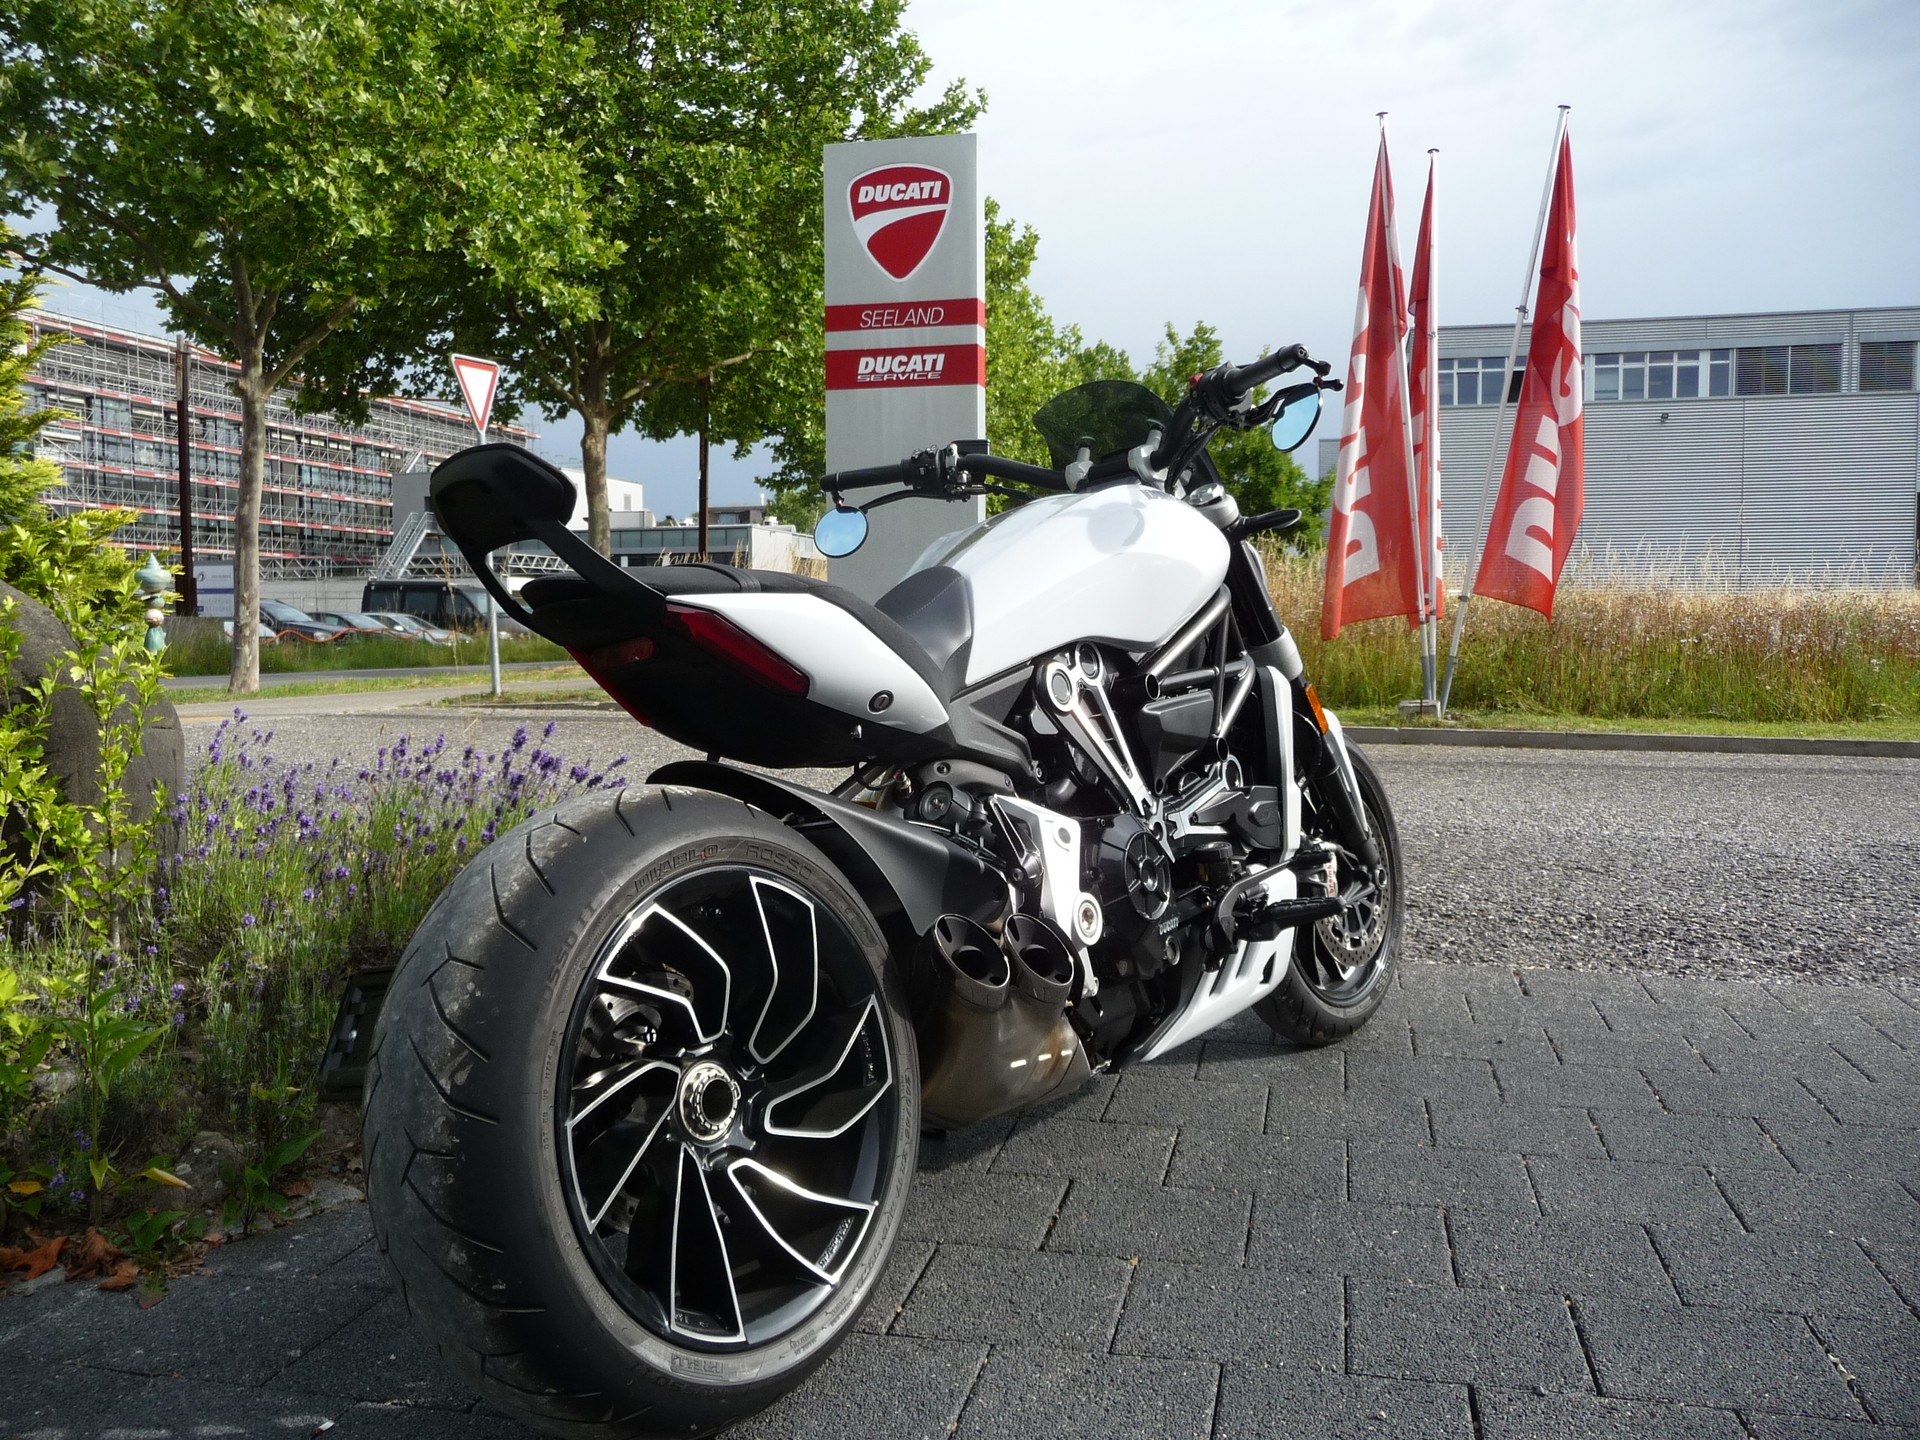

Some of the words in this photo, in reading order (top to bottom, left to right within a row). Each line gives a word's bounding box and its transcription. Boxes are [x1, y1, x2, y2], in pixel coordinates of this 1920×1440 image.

[858, 181, 942, 203] DUCATI
[859, 307, 944, 328] SEELAND
[857, 353, 945, 374] DUCATI
[857, 372, 941, 382] SERVICE
[633, 844, 719, 893] DIABLO
[1326, 863, 1335, 895] bremb
